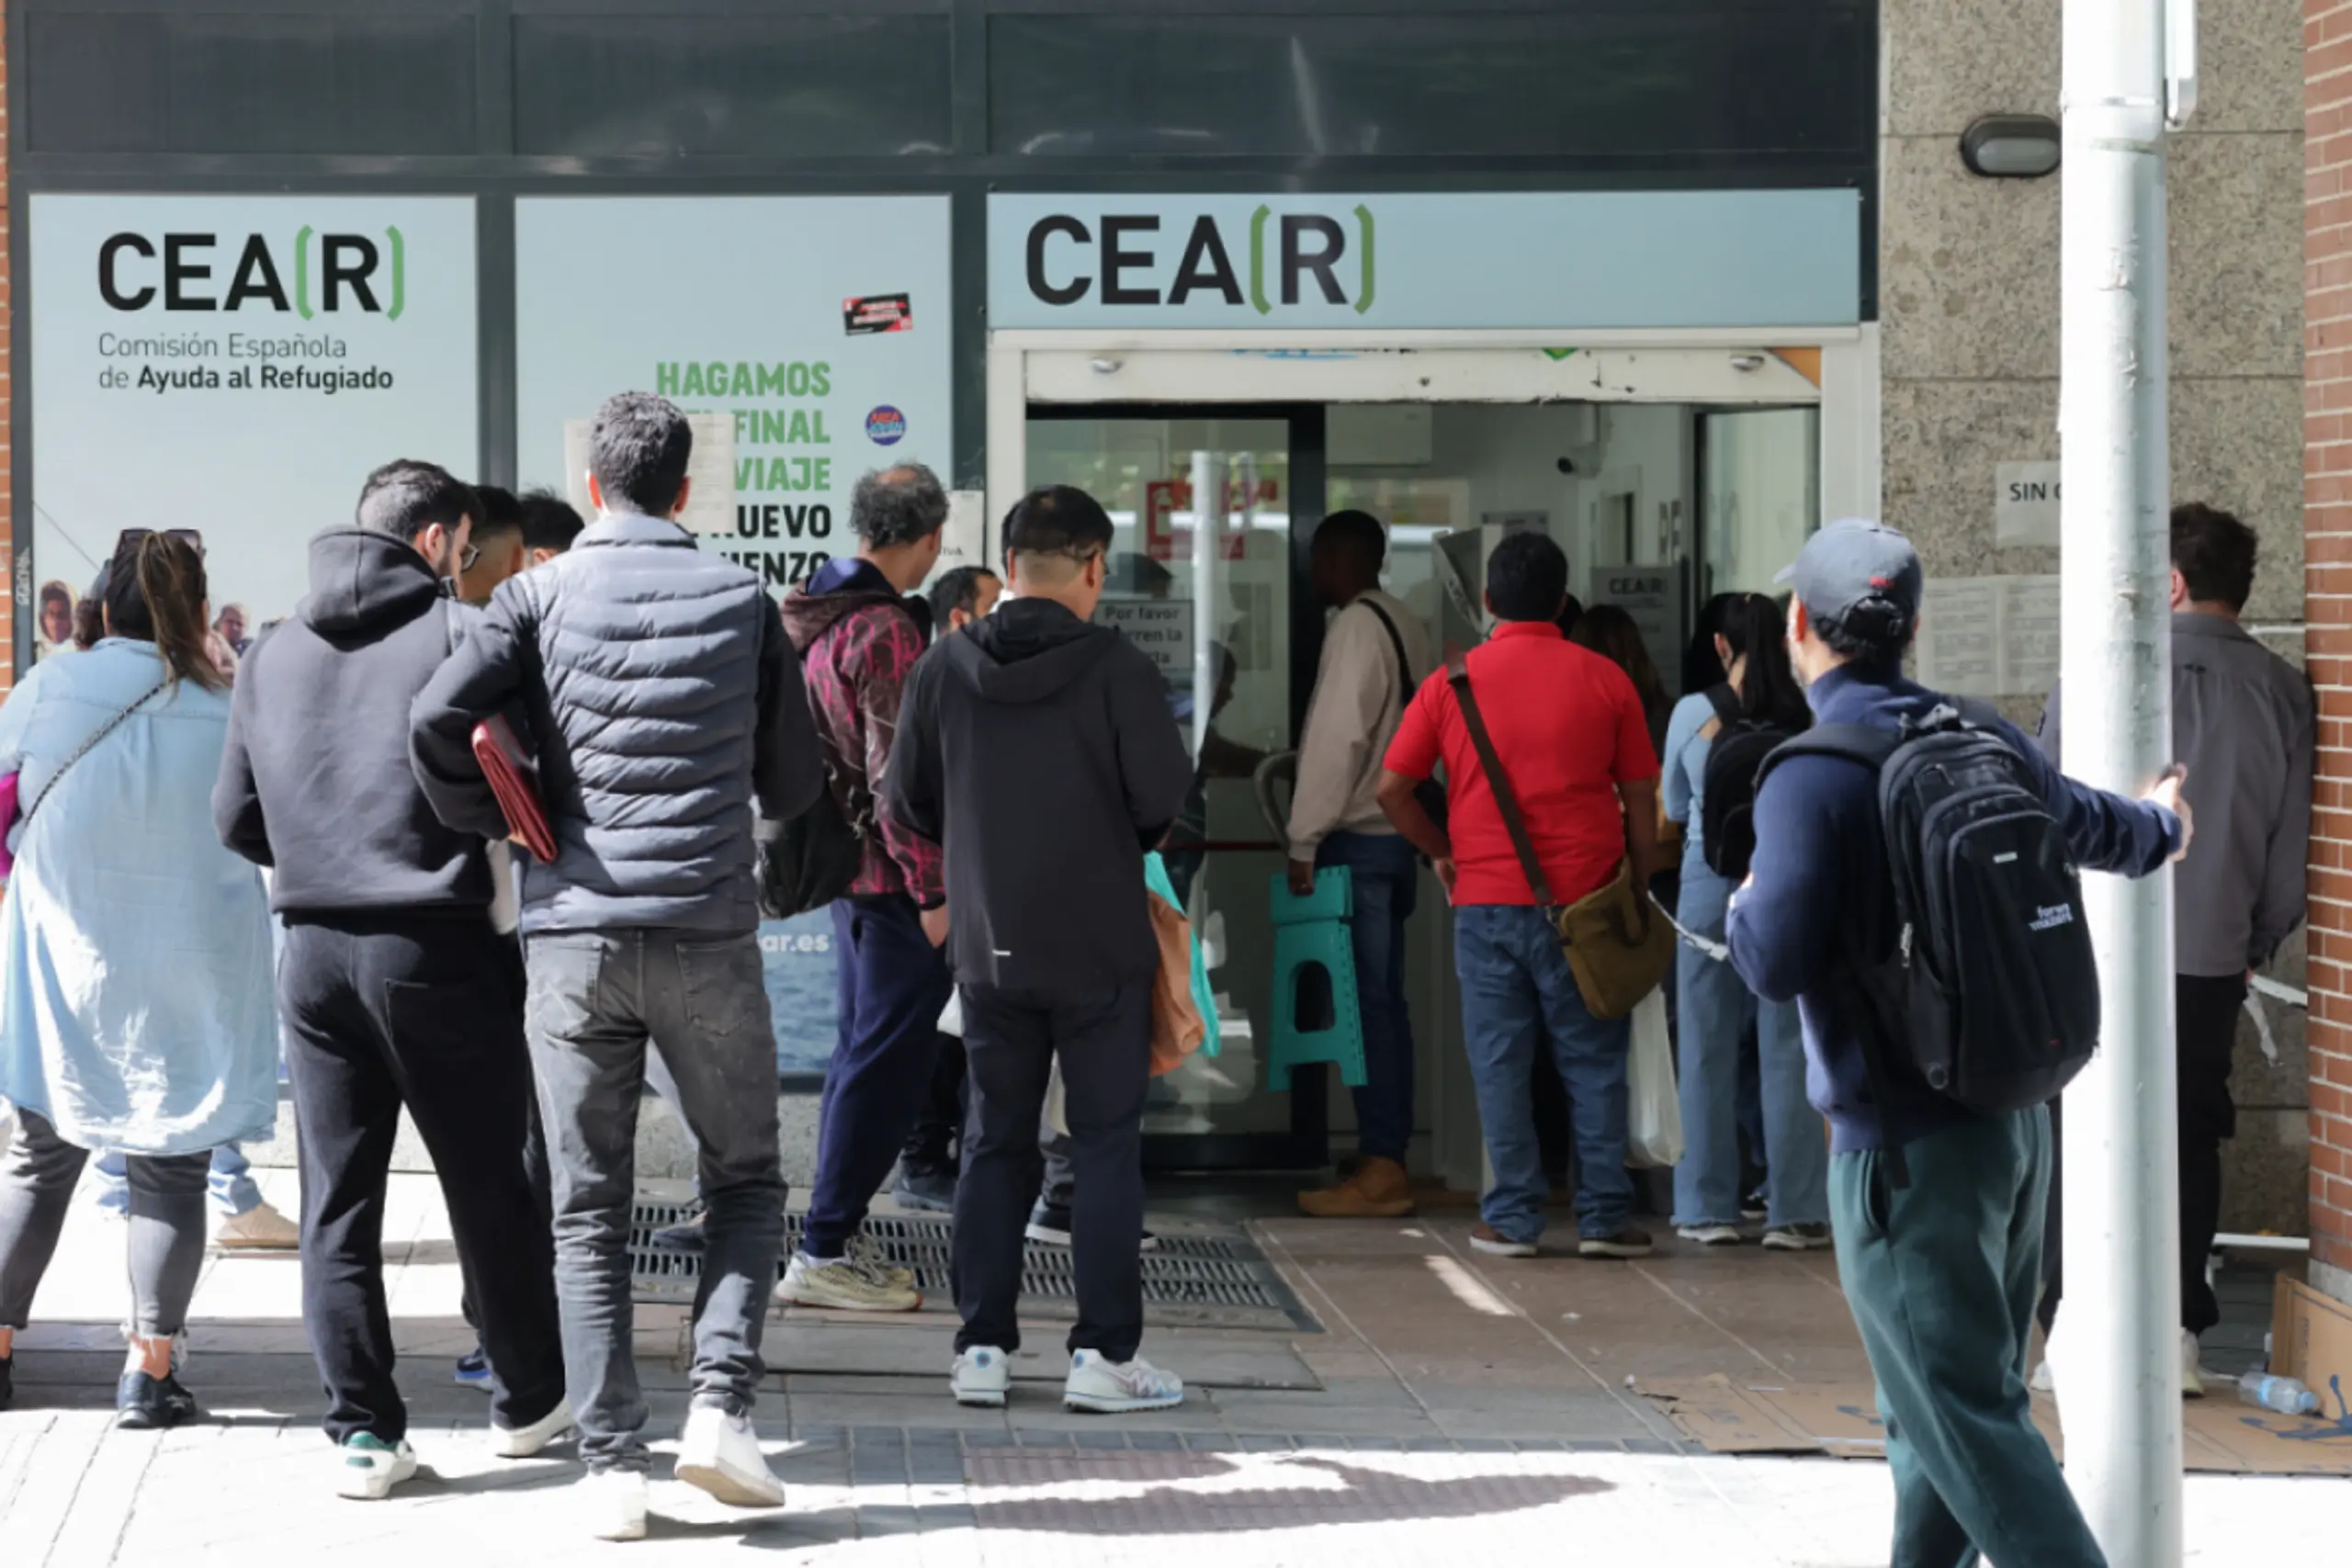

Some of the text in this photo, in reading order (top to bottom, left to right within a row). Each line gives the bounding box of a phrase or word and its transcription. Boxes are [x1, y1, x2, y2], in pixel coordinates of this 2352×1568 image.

[98, 225, 405, 321] CEA(R)
[1025, 204, 1375, 316] CEA(R)
[98, 333, 346, 363] Comisión Española
[99, 365, 394, 395] de Ayuda al Refugiado
[656, 362, 831, 398] HAGAMOS
[734, 457, 831, 491] VIAJE
[2009, 481, 2047, 502] SIN
[711, 504, 831, 539] UEVO
[1138, 605, 1181, 620] favor
[758, 933, 830, 953] ar.es
